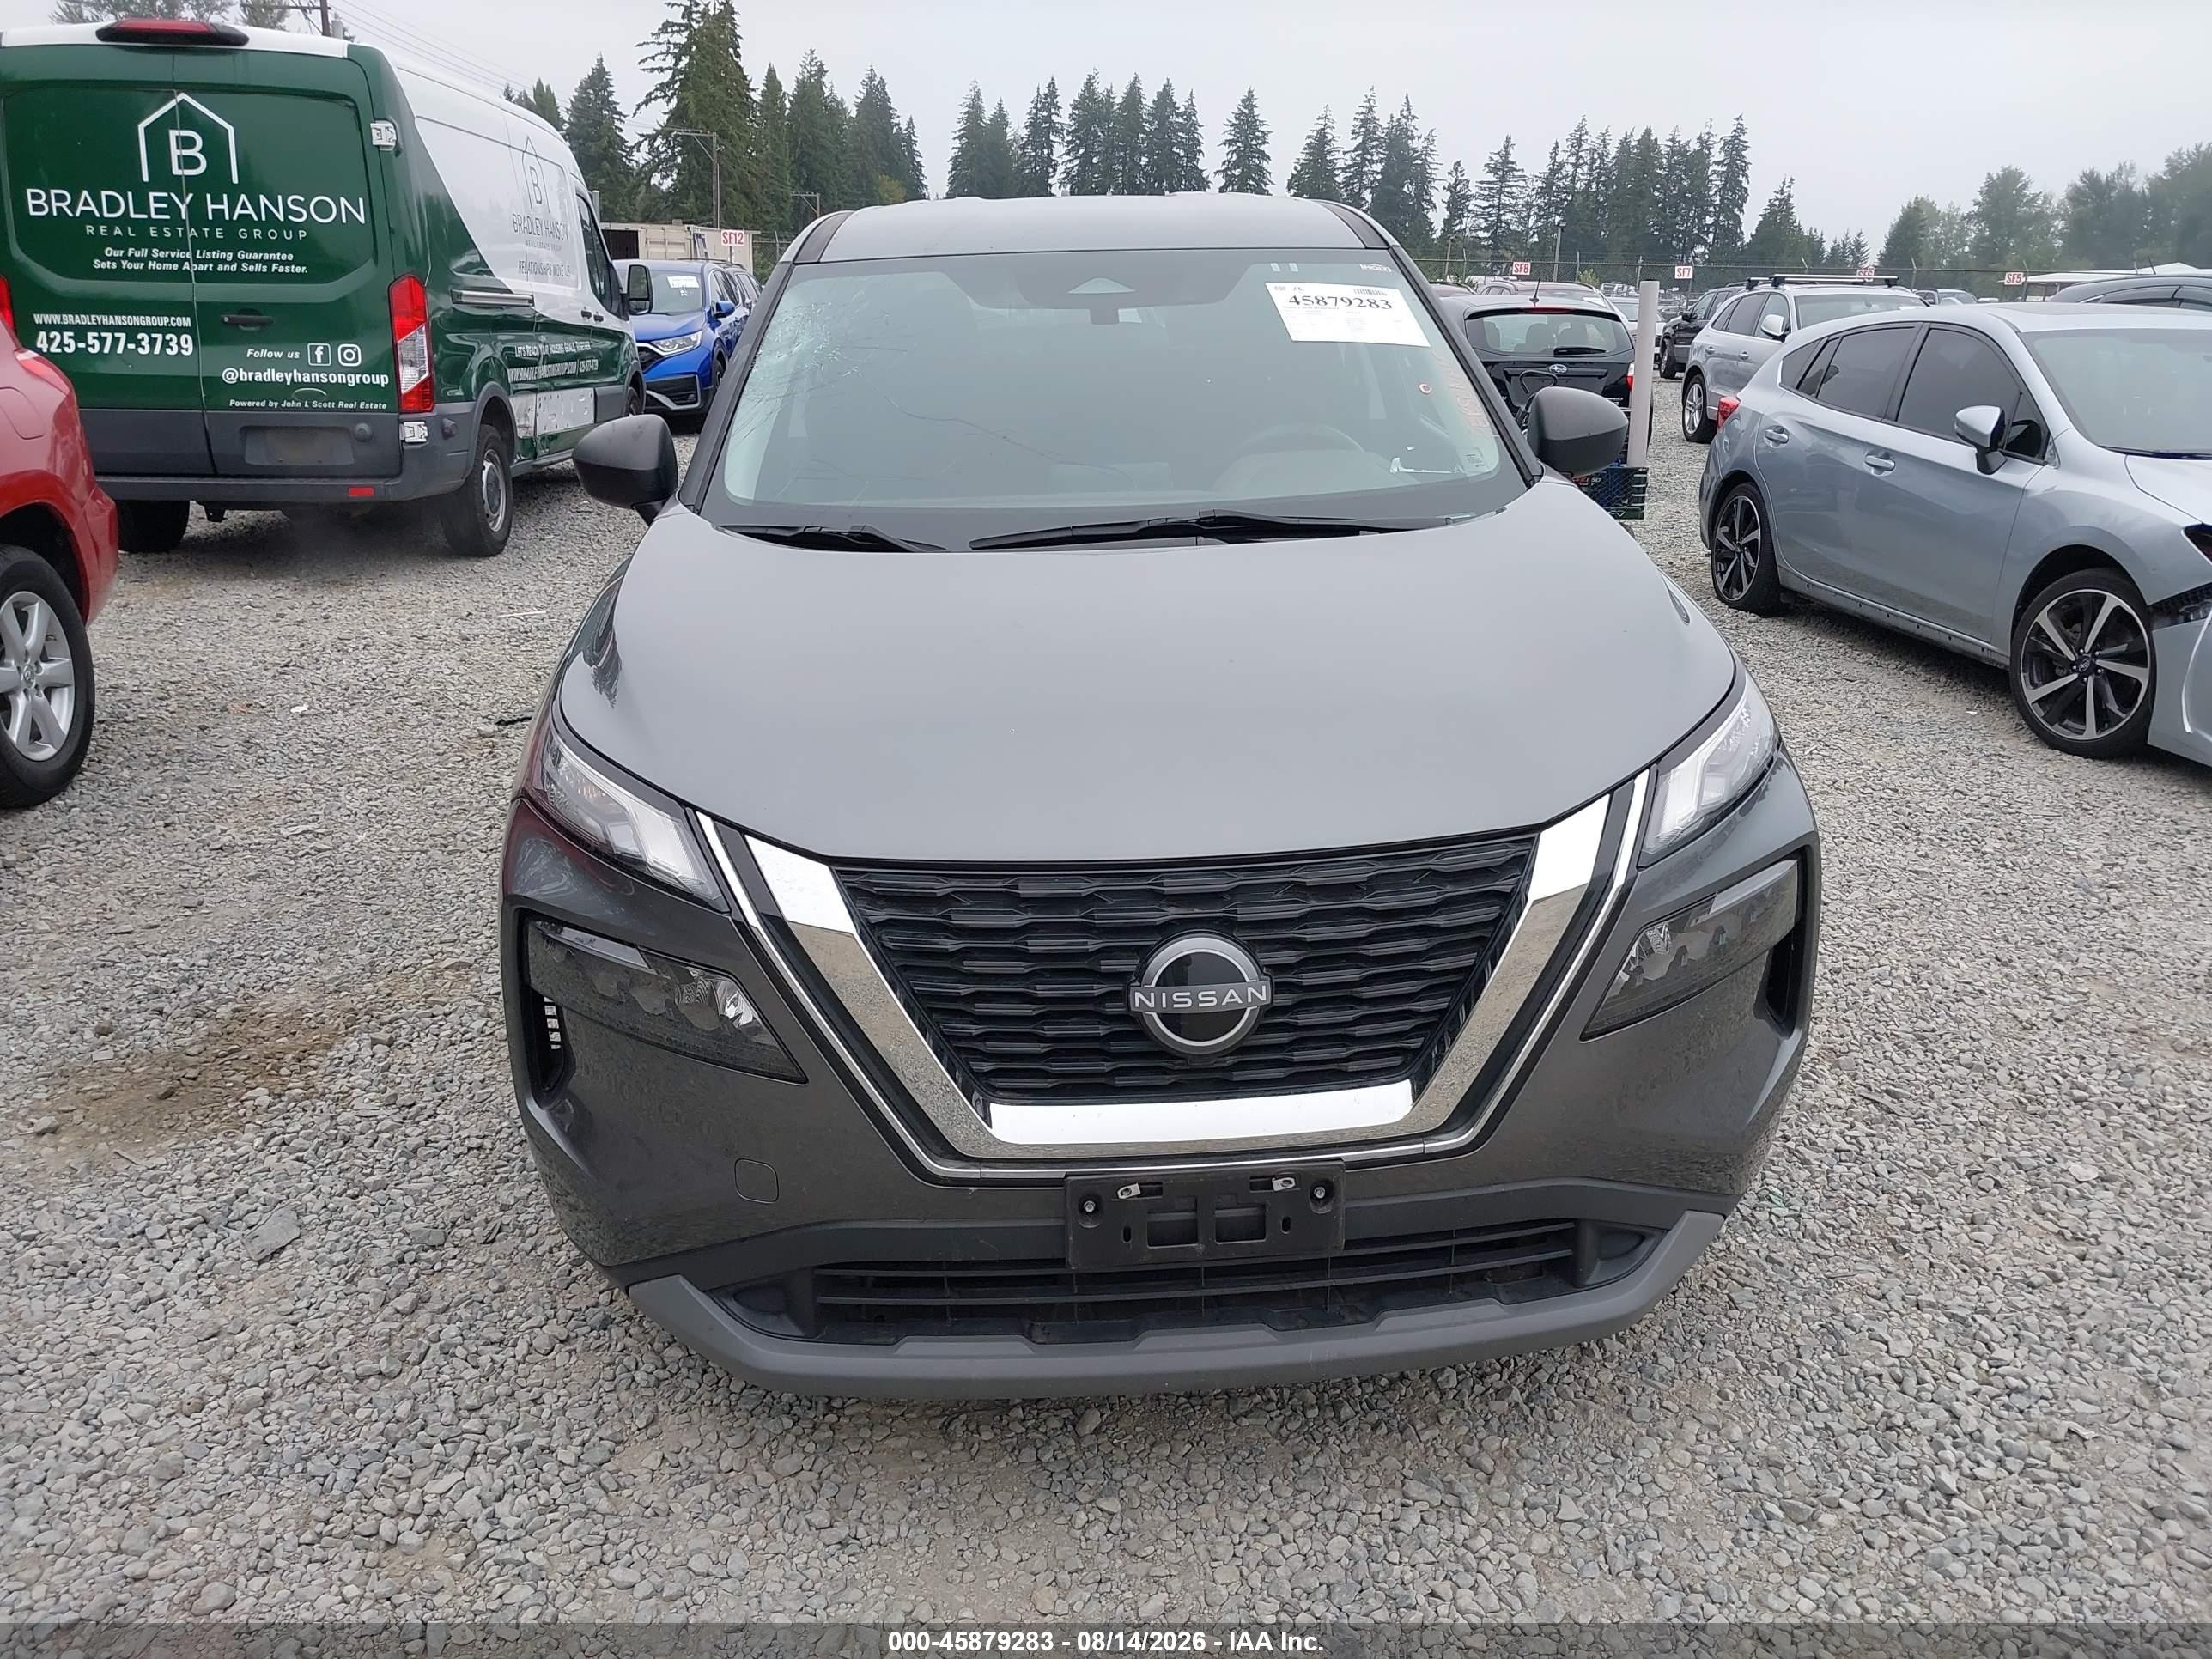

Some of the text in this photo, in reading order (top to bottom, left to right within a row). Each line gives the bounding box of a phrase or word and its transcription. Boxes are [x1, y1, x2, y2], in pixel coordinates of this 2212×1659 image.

[169, 130, 207, 175] B
[528, 166, 543, 204] B
[27, 188, 365, 224] BRADLEY HANSON
[86, 225, 307, 240] REAL ESTATE GROUP
[513, 214, 544, 236] BRADLEY
[722, 231, 744, 245] SF12
[105, 246, 294, 262] Our Full Service Listing Guarantee
[93, 259, 308, 274] Sets Your Home Apart and Sells Faster.
[1514, 263, 1529, 274] SF8
[1677, 267, 1692, 278] SF7
[2006, 273, 2021, 283] SF5
[1289, 295, 1394, 310] 45879283
[33, 313, 191, 327] WWW.BRADLEYHANSONGROUP.COM
[36, 331, 194, 356] 425-577-3739
[246, 349, 283, 359] Follow
[287, 349, 301, 359] us
[222, 367, 389, 387] @bradleyhansongroup
[229, 399, 266, 408] Powered
[268, 399, 279, 410] by
[281, 399, 301, 408] John
[312, 400, 335, 409] Scott
[337, 400, 357, 409] Real
[359, 401, 387, 410] Estate
[1134, 984, 1267, 1008] NISSAN
